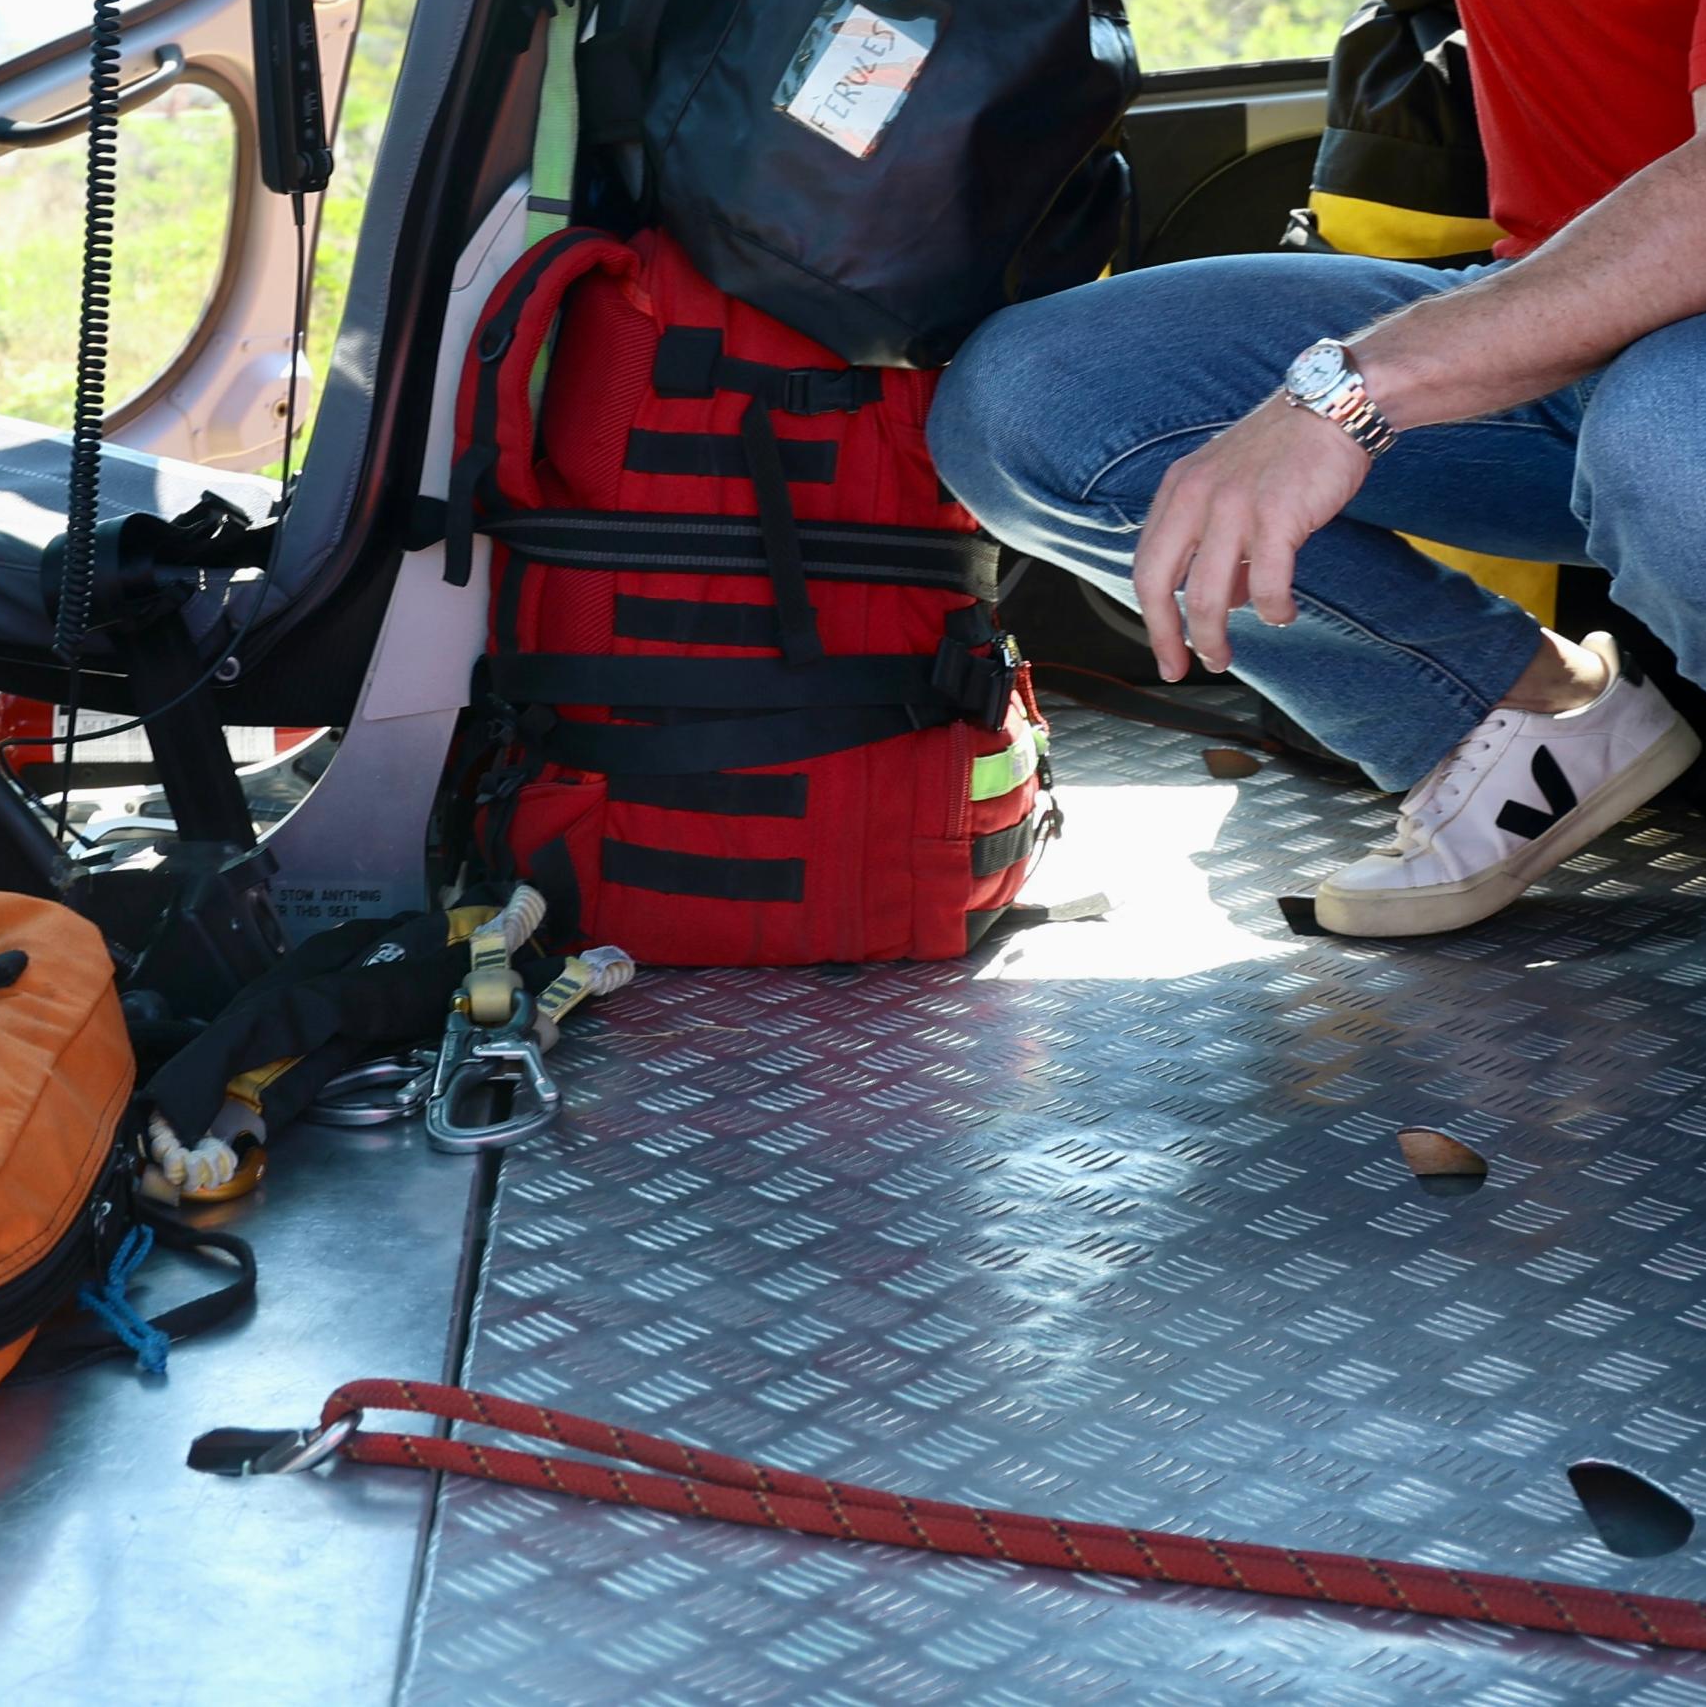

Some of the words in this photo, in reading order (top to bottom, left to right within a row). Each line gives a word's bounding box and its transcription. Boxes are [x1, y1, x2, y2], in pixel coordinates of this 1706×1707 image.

[279, 888, 314, 902] STOW
[321, 888, 382, 902] ANYTHING
[294, 905, 322, 918] THIS
[327, 905, 358, 918] SEAT
